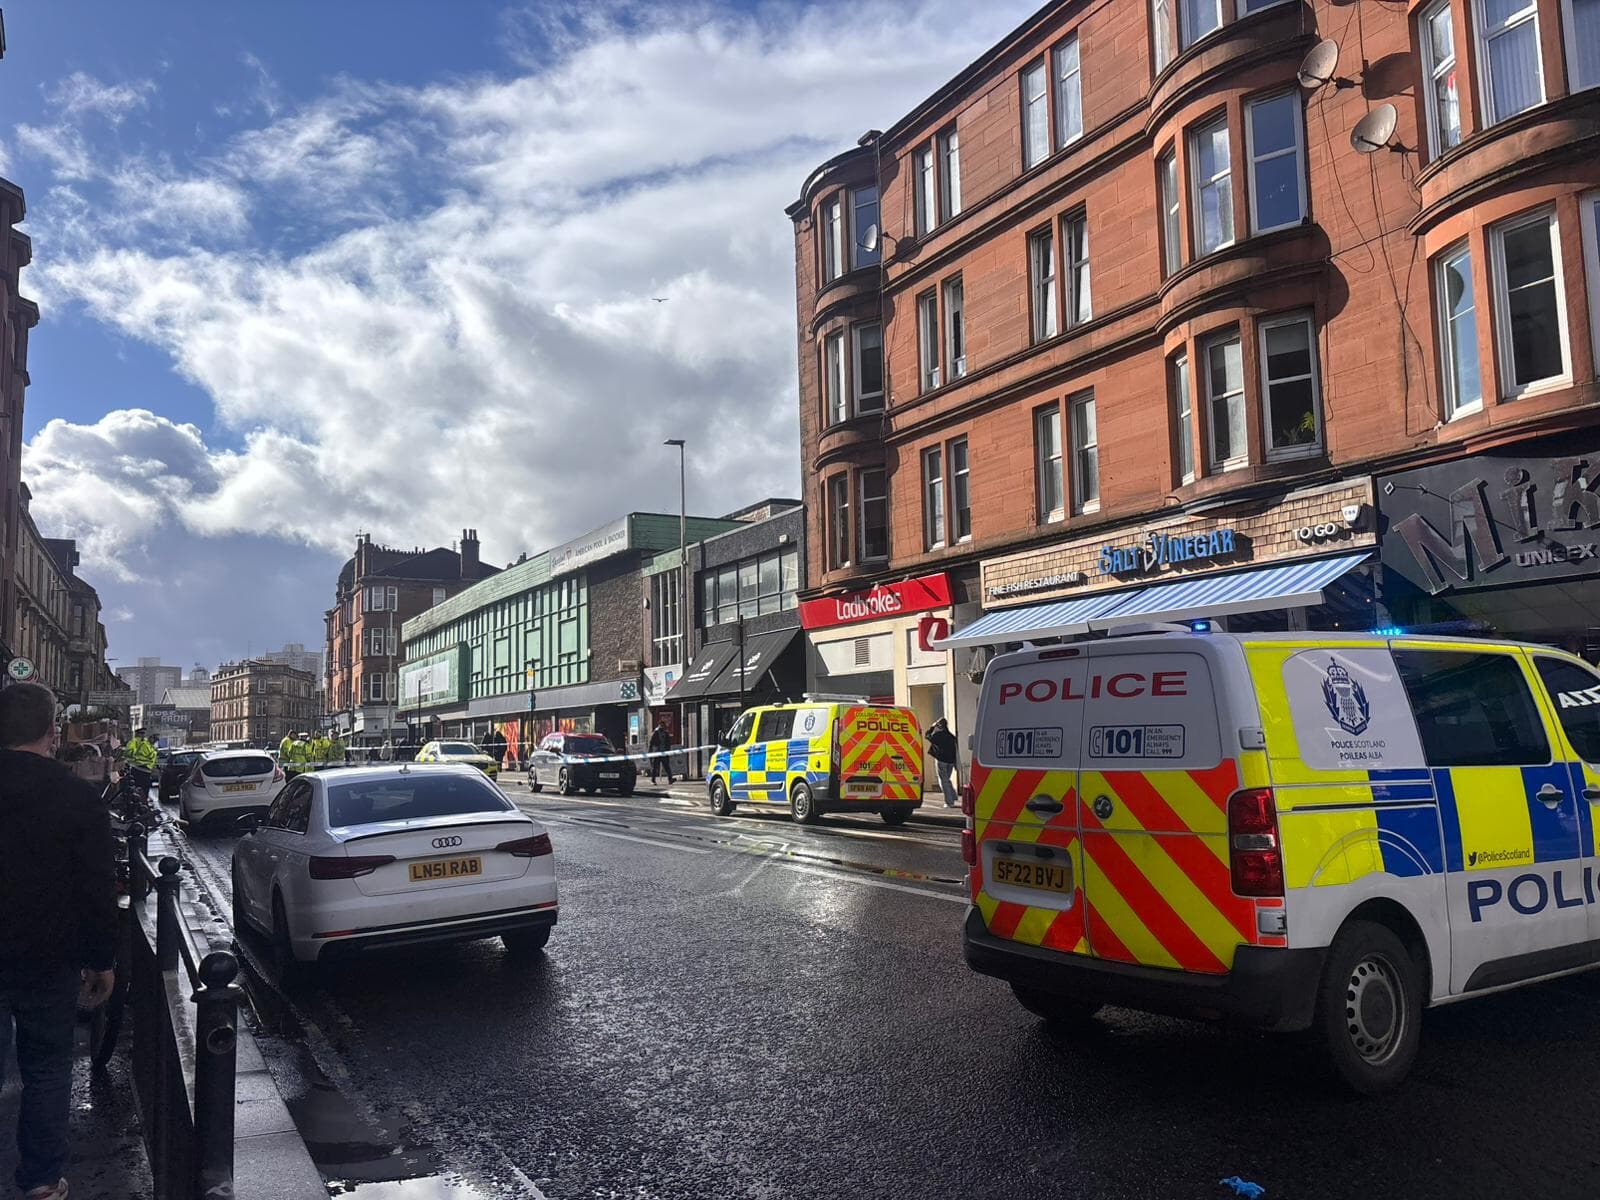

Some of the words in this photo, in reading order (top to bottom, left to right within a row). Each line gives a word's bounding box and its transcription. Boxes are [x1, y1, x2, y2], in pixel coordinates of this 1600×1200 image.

[1292, 527, 1311, 540] TO
[1314, 522, 1336, 537] GO
[1153, 529, 1235, 565] VINEGAR
[1515, 542, 1597, 567] UNISEX
[1006, 581, 1023, 593] FISH
[1023, 571, 1081, 590] RESTAURANT
[836, 590, 902, 620] Ladbrokes
[1000, 671, 1187, 705] POLICE
[857, 721, 909, 732] POLICE
[1007, 731, 1033, 754] 101
[1105, 729, 1143, 754] 101
[1146, 734, 1181, 742] EMERGENCY
[1331, 741, 1353, 749] POLICE
[1354, 740, 1386, 749] SCOTLAND
[1340, 752, 1367, 760] POILEAS
[1368, 751, 1383, 759] ALBA
[1477, 848, 1530, 865] @PoliceScotland
[413, 862, 446, 880] LN51
[451, 859, 479, 875] RAB
[998, 861, 1032, 884] SF22
[1036, 866, 1065, 889] BVJ
[1467, 867, 1600, 923] POLI
